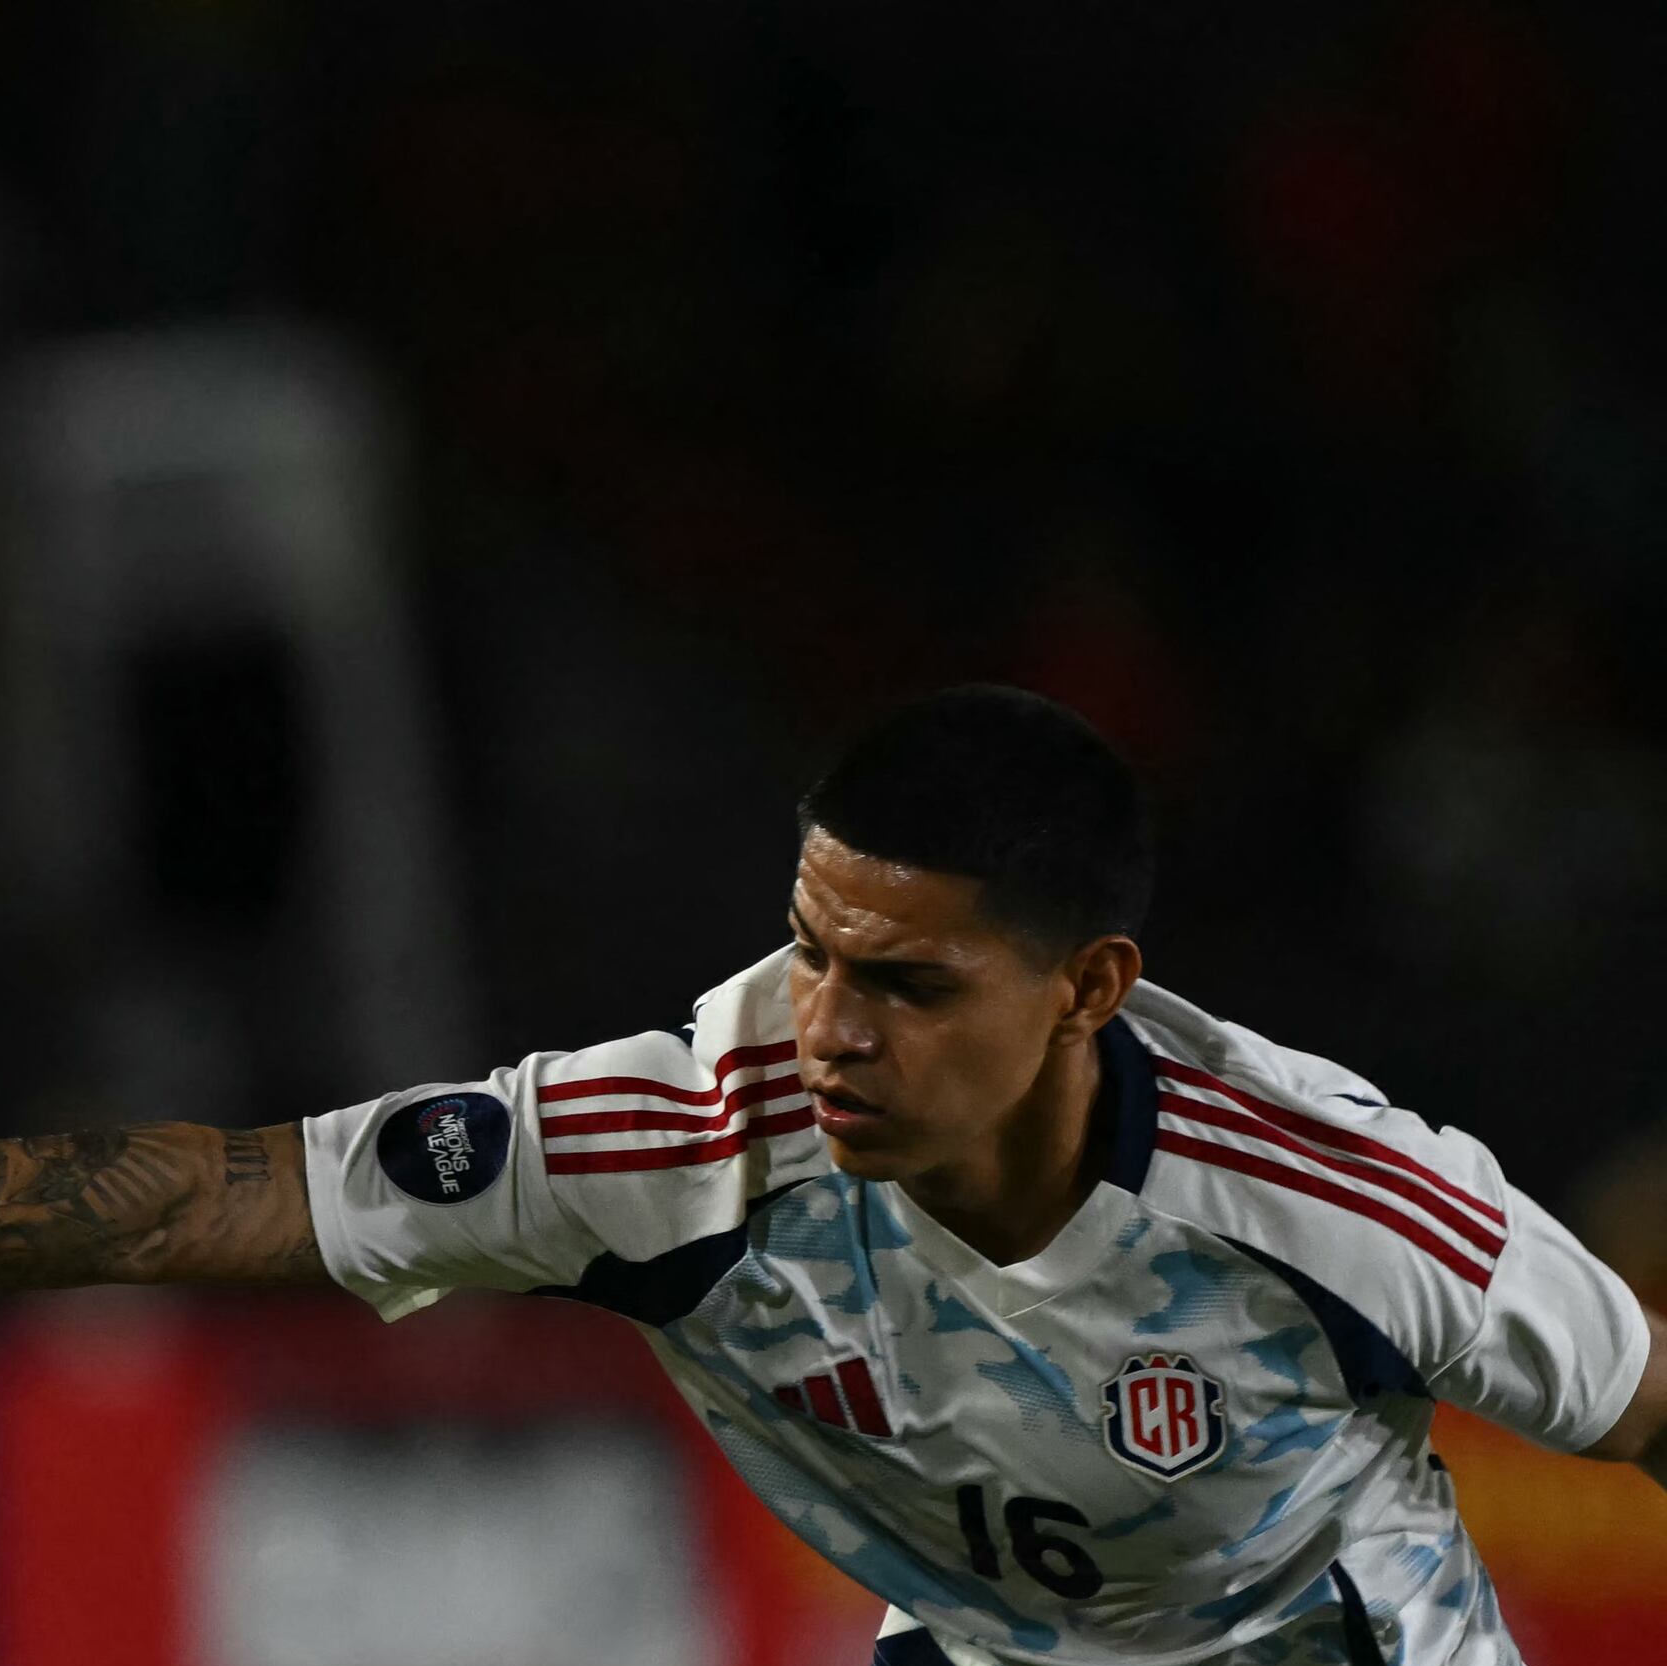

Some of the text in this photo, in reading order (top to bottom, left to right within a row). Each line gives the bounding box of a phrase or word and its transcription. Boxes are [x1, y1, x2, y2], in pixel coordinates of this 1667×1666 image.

[427, 1133, 461, 1195] LEAGUE
[437, 1113, 471, 1173] NATIONS
[1129, 1376, 1200, 1458] CR
[956, 1483, 1105, 1601] 16
